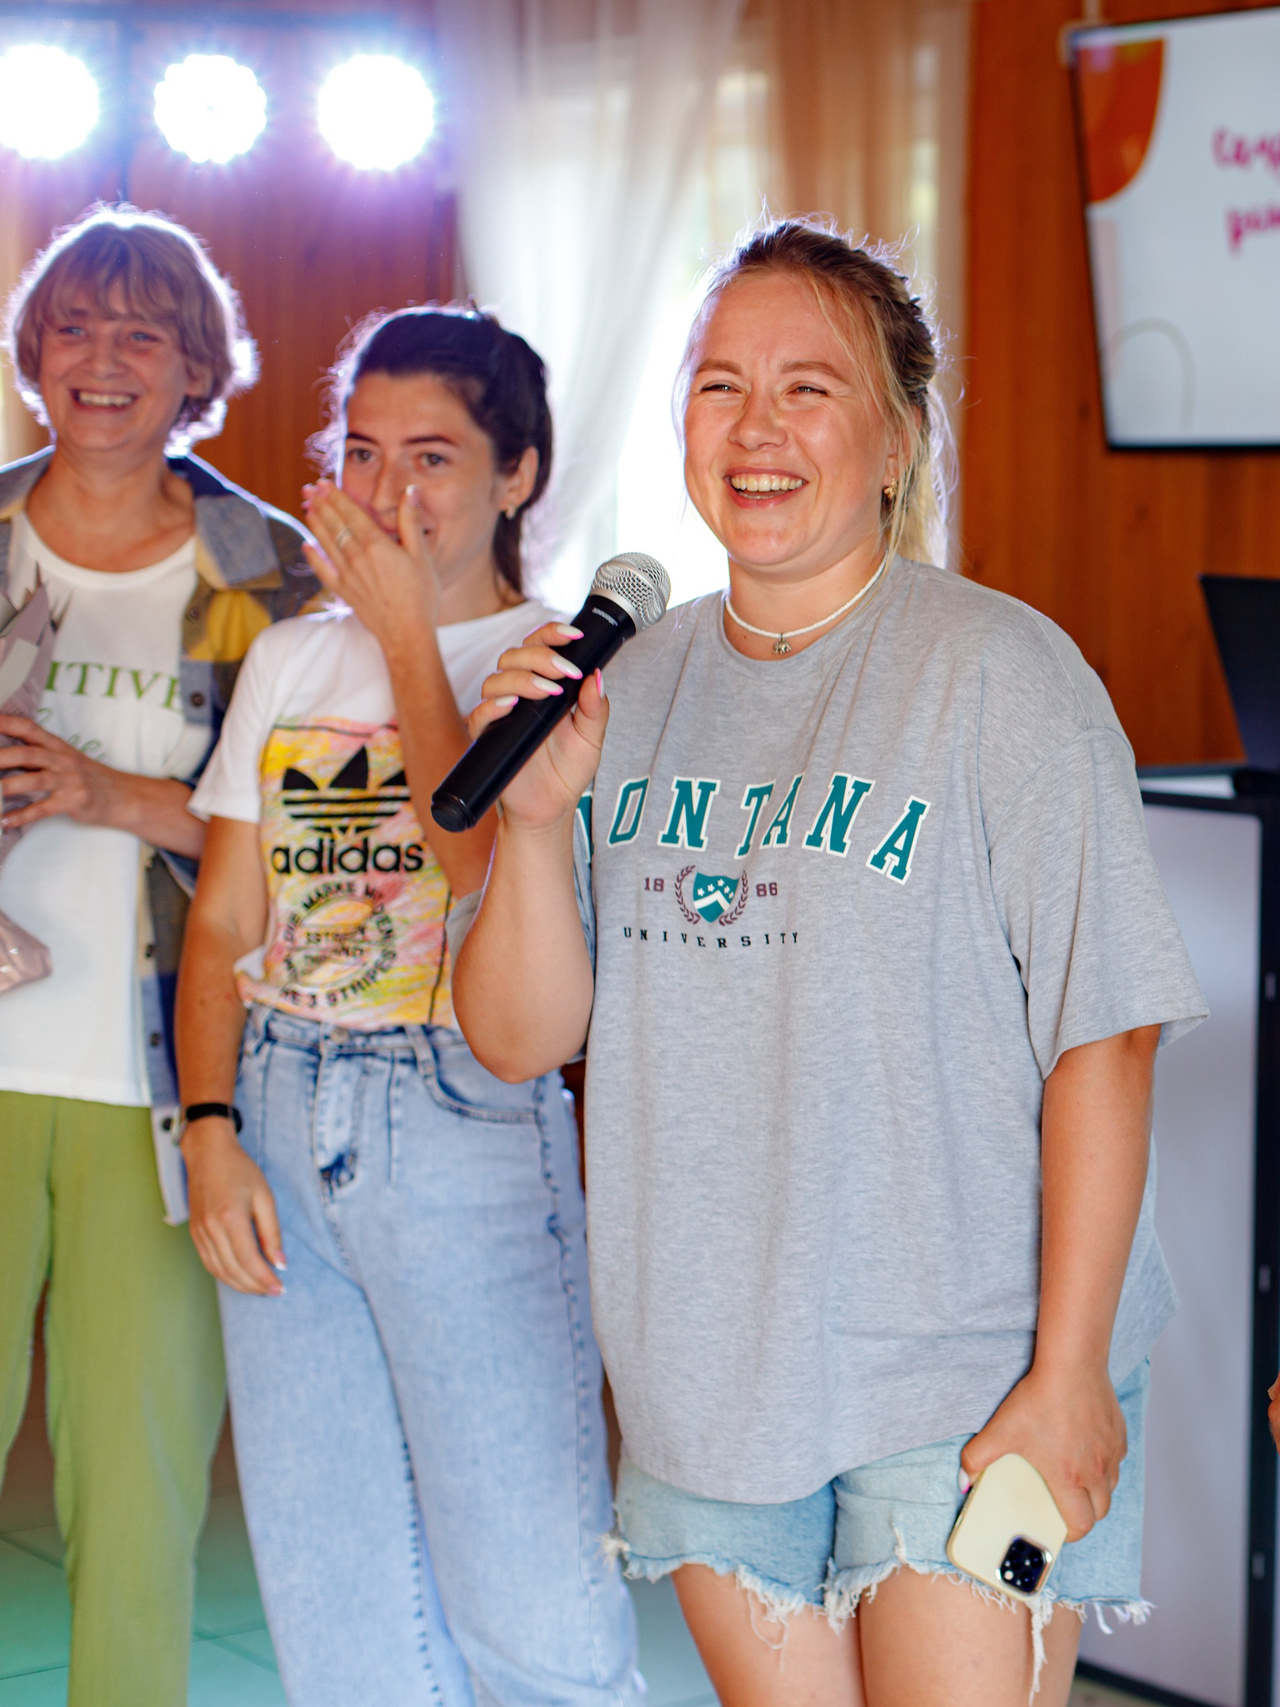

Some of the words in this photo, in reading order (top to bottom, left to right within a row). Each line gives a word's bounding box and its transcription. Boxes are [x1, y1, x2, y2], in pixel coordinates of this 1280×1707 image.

[271, 837, 424, 874] adidas
[644, 877, 665, 893] 18
[755, 882, 778, 898] 86
[623, 926, 799, 949] UNIVERSITY
